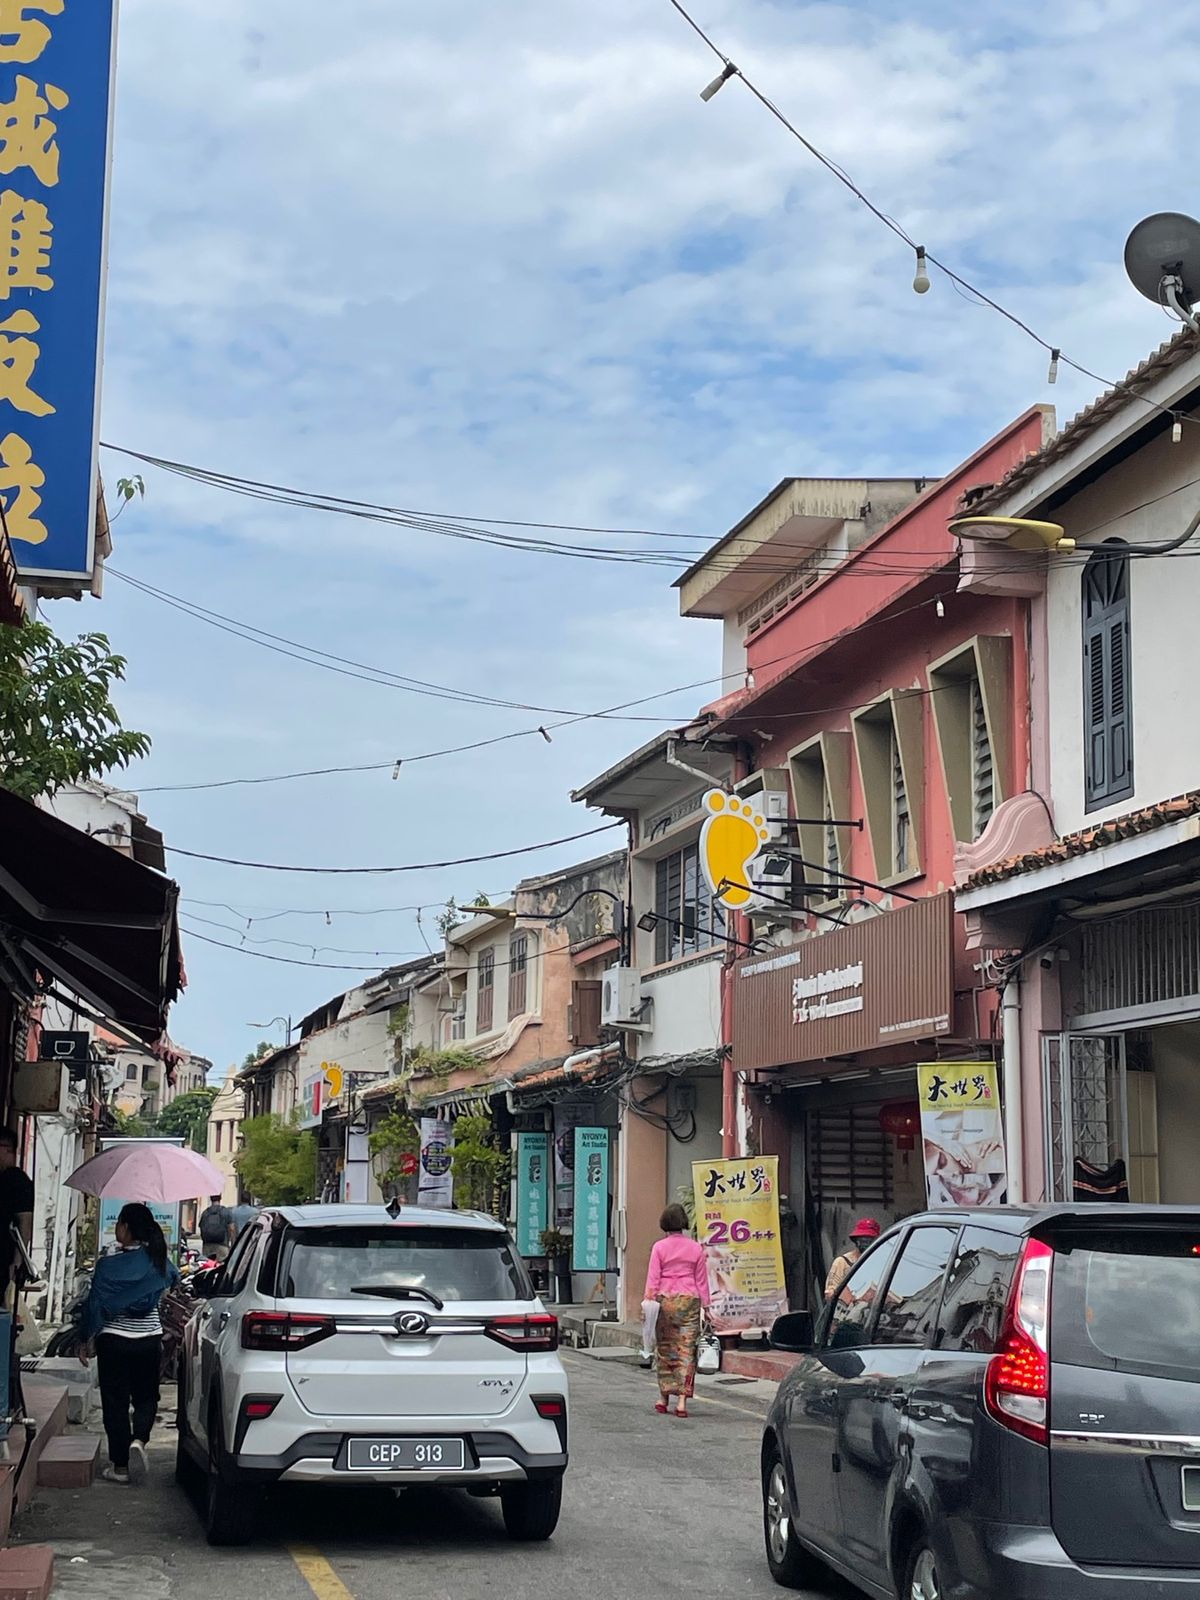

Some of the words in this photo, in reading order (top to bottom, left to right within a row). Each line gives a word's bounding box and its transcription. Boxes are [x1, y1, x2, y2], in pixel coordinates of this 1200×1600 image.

[928, 1074, 986, 1101] 大世界
[704, 1168, 765, 1198] 大世界
[705, 1212, 721, 1220] RM
[369, 1444, 401, 1462] CEP
[415, 1444, 442, 1462] 313
